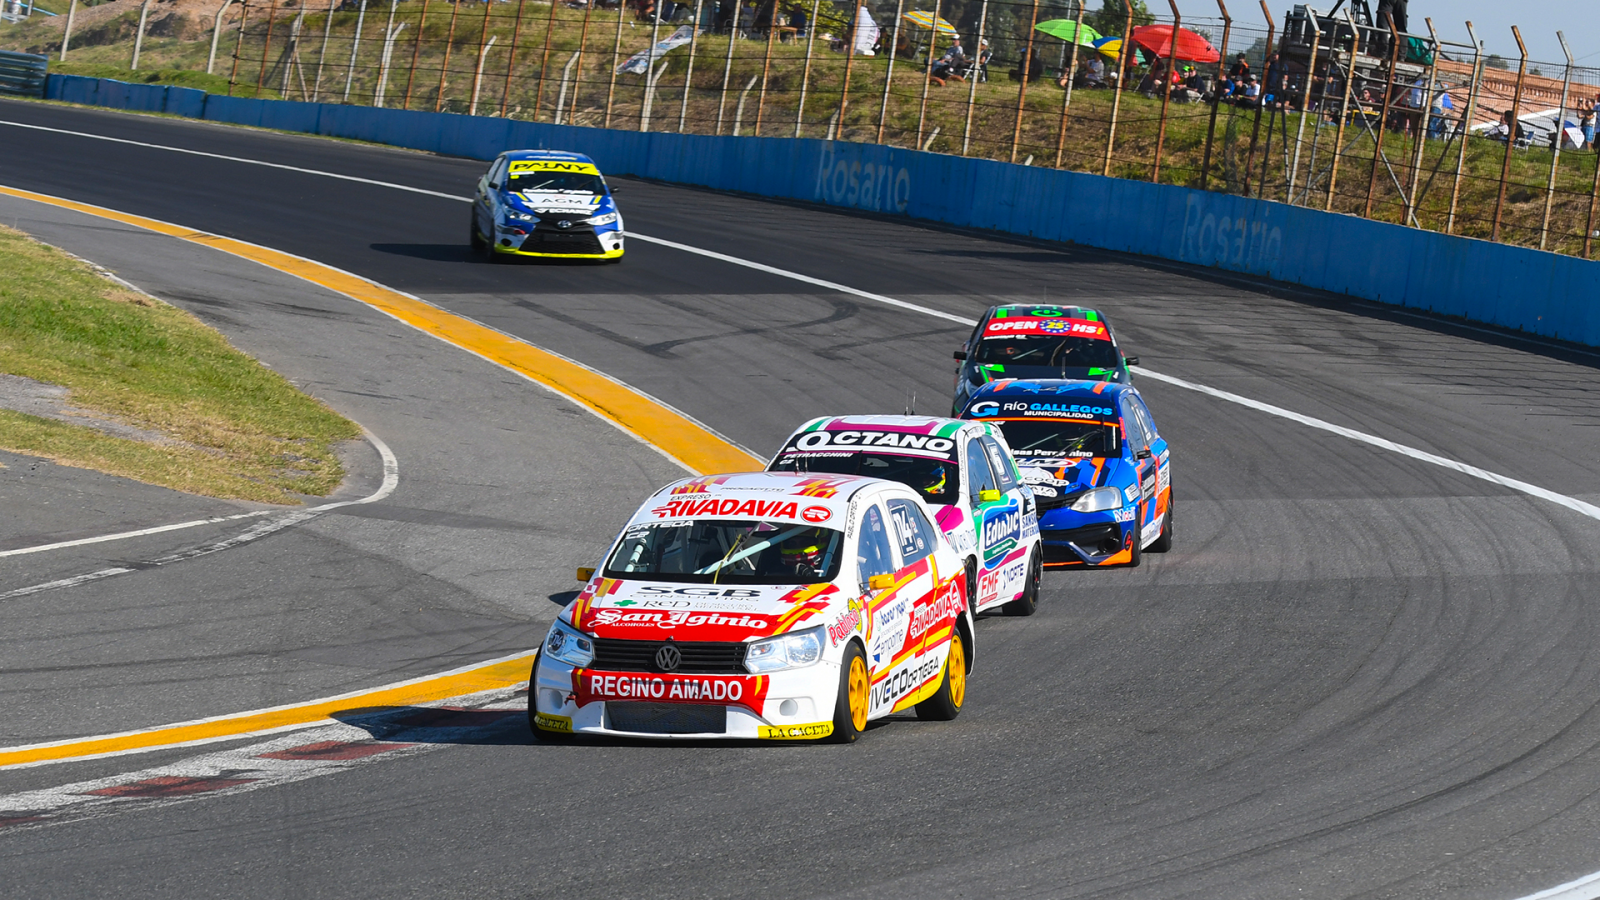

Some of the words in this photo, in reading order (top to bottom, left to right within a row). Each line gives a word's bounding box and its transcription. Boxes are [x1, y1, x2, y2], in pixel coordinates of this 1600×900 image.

[815, 140, 910, 212] Rosario
[1180, 193, 1282, 268] Rosario
[989, 321, 1038, 331] OPEN
[1072, 324, 1104, 334] HS!
[1003, 401, 1027, 411] RÍO
[1030, 403, 1113, 415] GALLEGOS
[1024, 410, 1093, 419] MUNICIPALIDAD
[797, 431, 954, 451] OCTANO
[651, 500, 798, 519] RIVADAVIA
[627, 520, 694, 533] ORTEGA
[637, 586, 761, 597] SGB
[981, 571, 999, 597] FMF
[630, 594, 759, 602] CONSULTING
[588, 609, 658, 627] San
[911, 594, 953, 638] RIVADAVIA
[591, 675, 665, 698] REGINO
[669, 679, 743, 701] AMADO
[870, 667, 908, 713] IVECO
[768, 728, 785, 738] LA
[788, 724, 831, 737] GACETA
